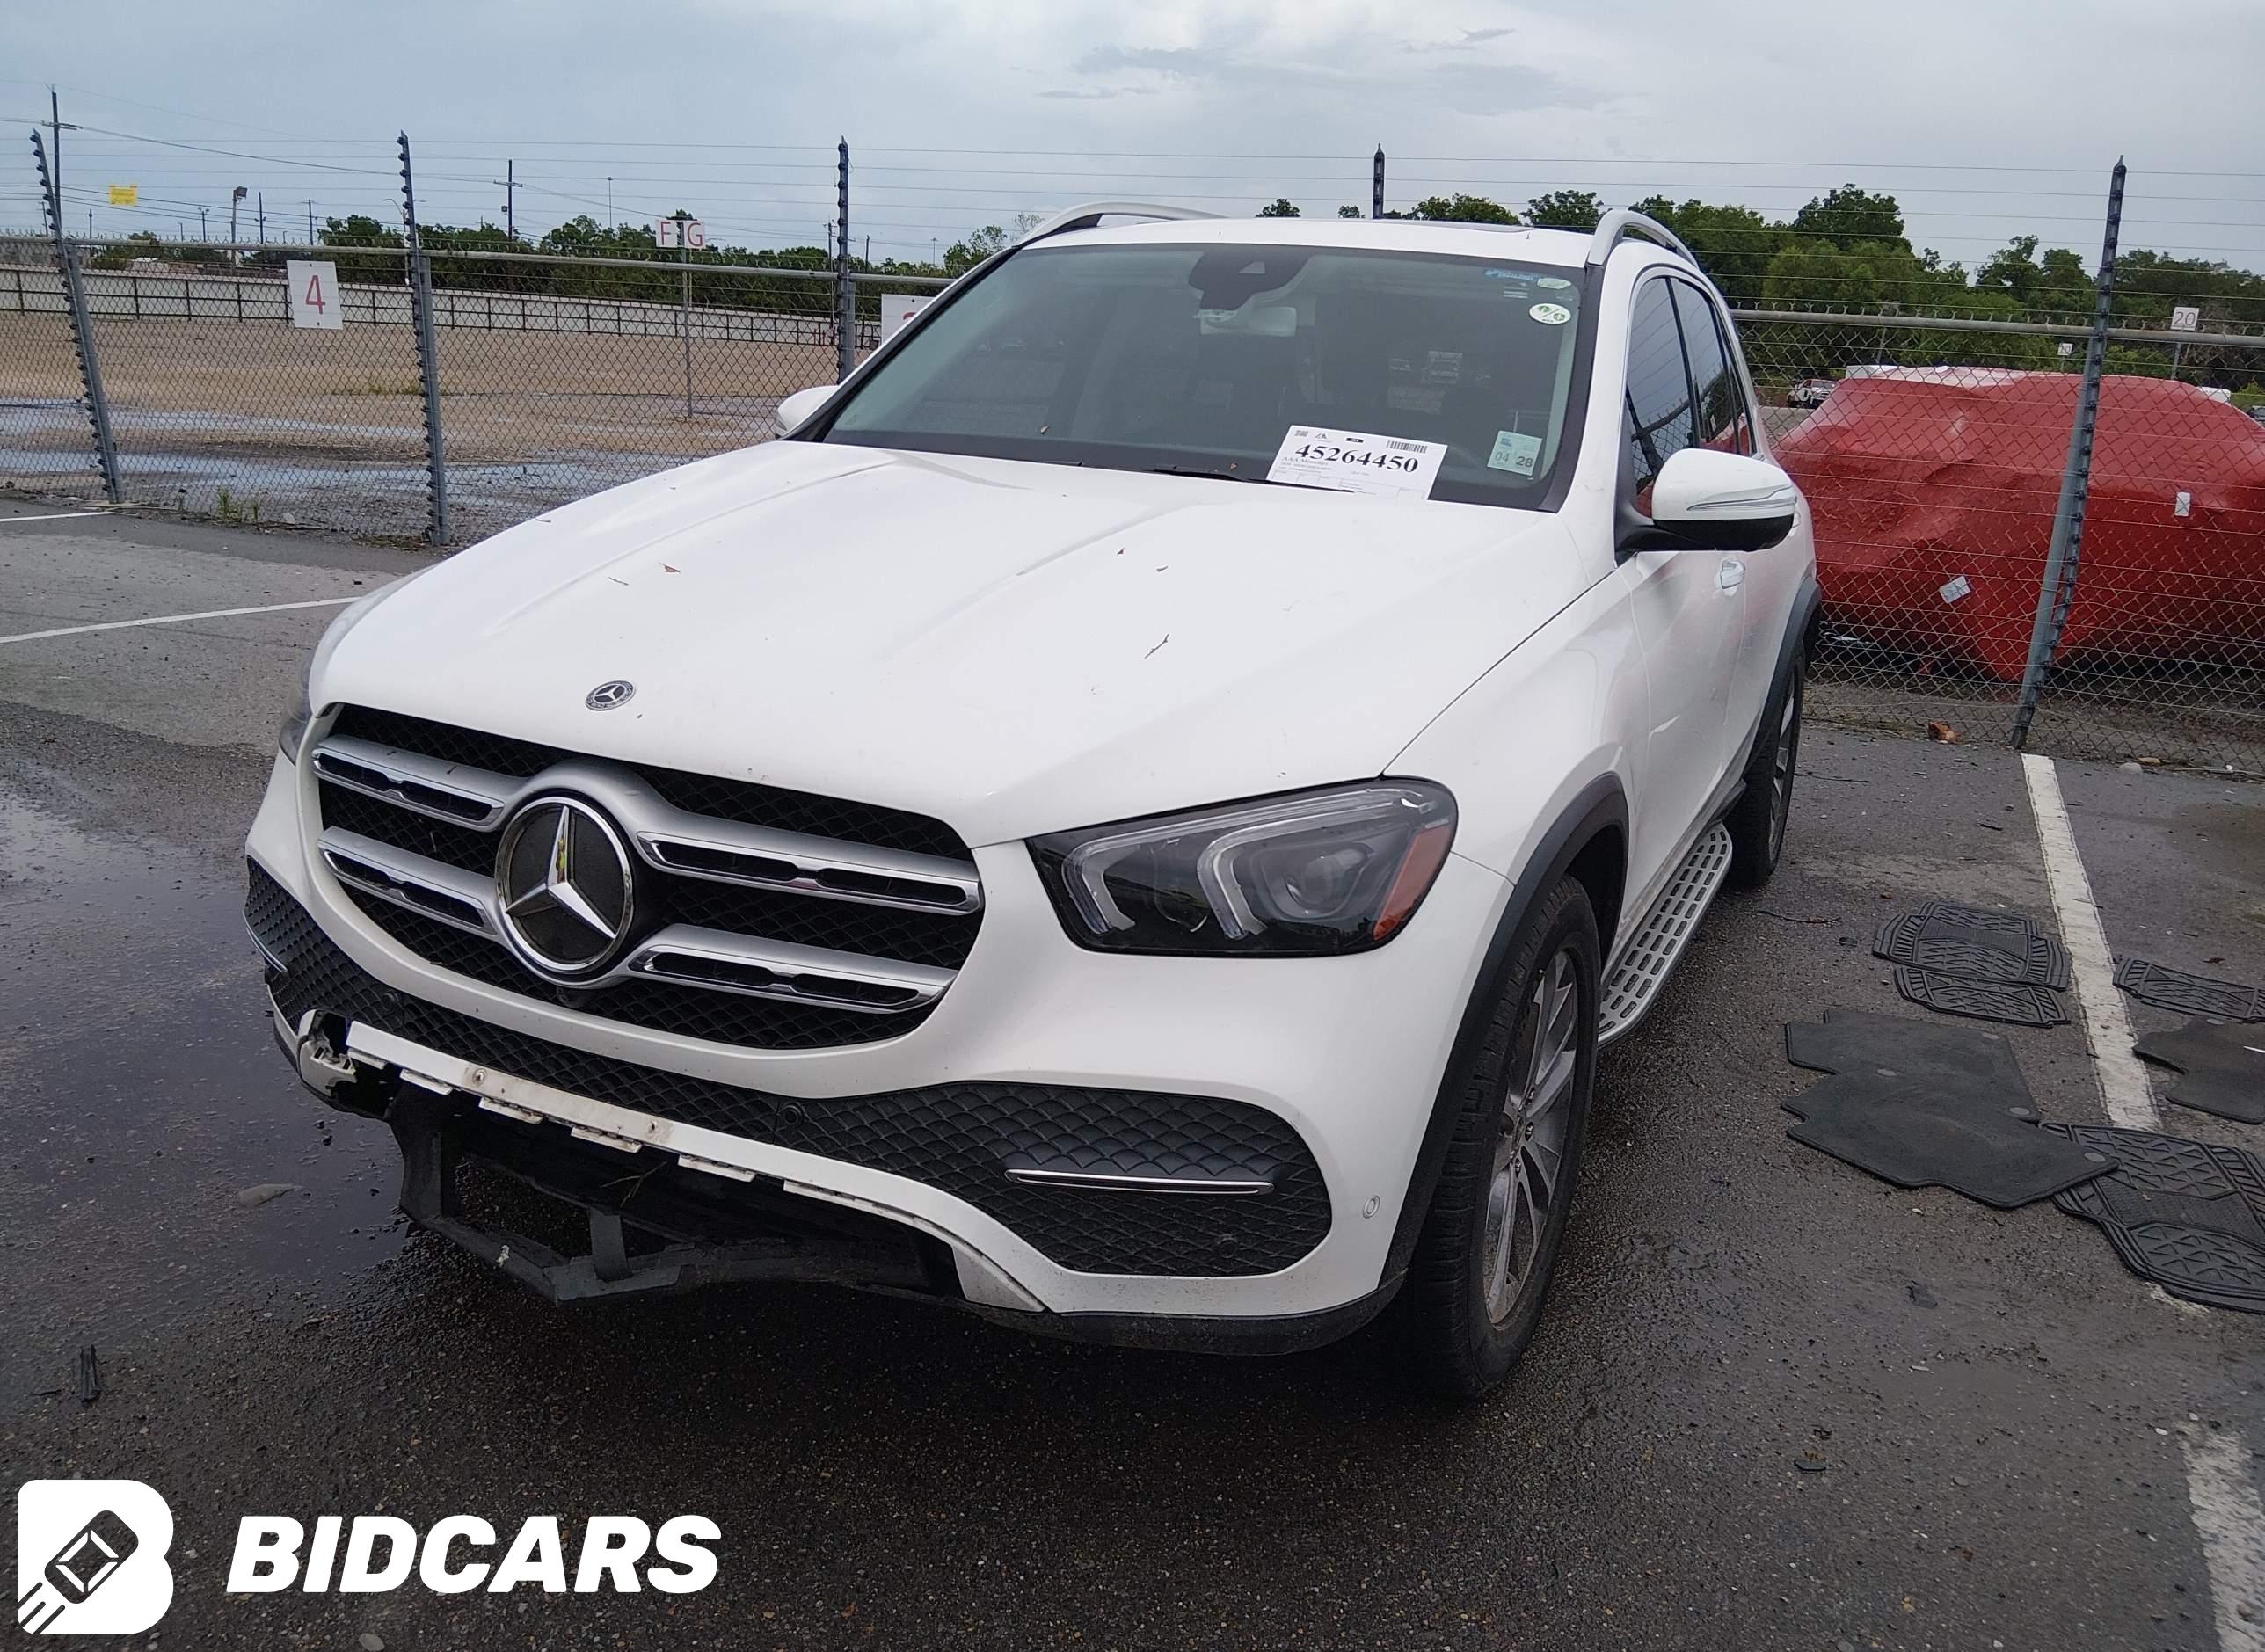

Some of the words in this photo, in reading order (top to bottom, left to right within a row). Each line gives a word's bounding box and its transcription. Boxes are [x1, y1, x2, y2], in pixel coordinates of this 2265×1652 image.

[660, 221, 671, 245] F
[687, 222, 703, 247] G
[305, 274, 326, 315] 4
[2174, 311, 2196, 326] 20
[1295, 443, 1418, 472] 45264450
[1495, 451, 1510, 462] 04
[1516, 455, 1533, 468] 28
